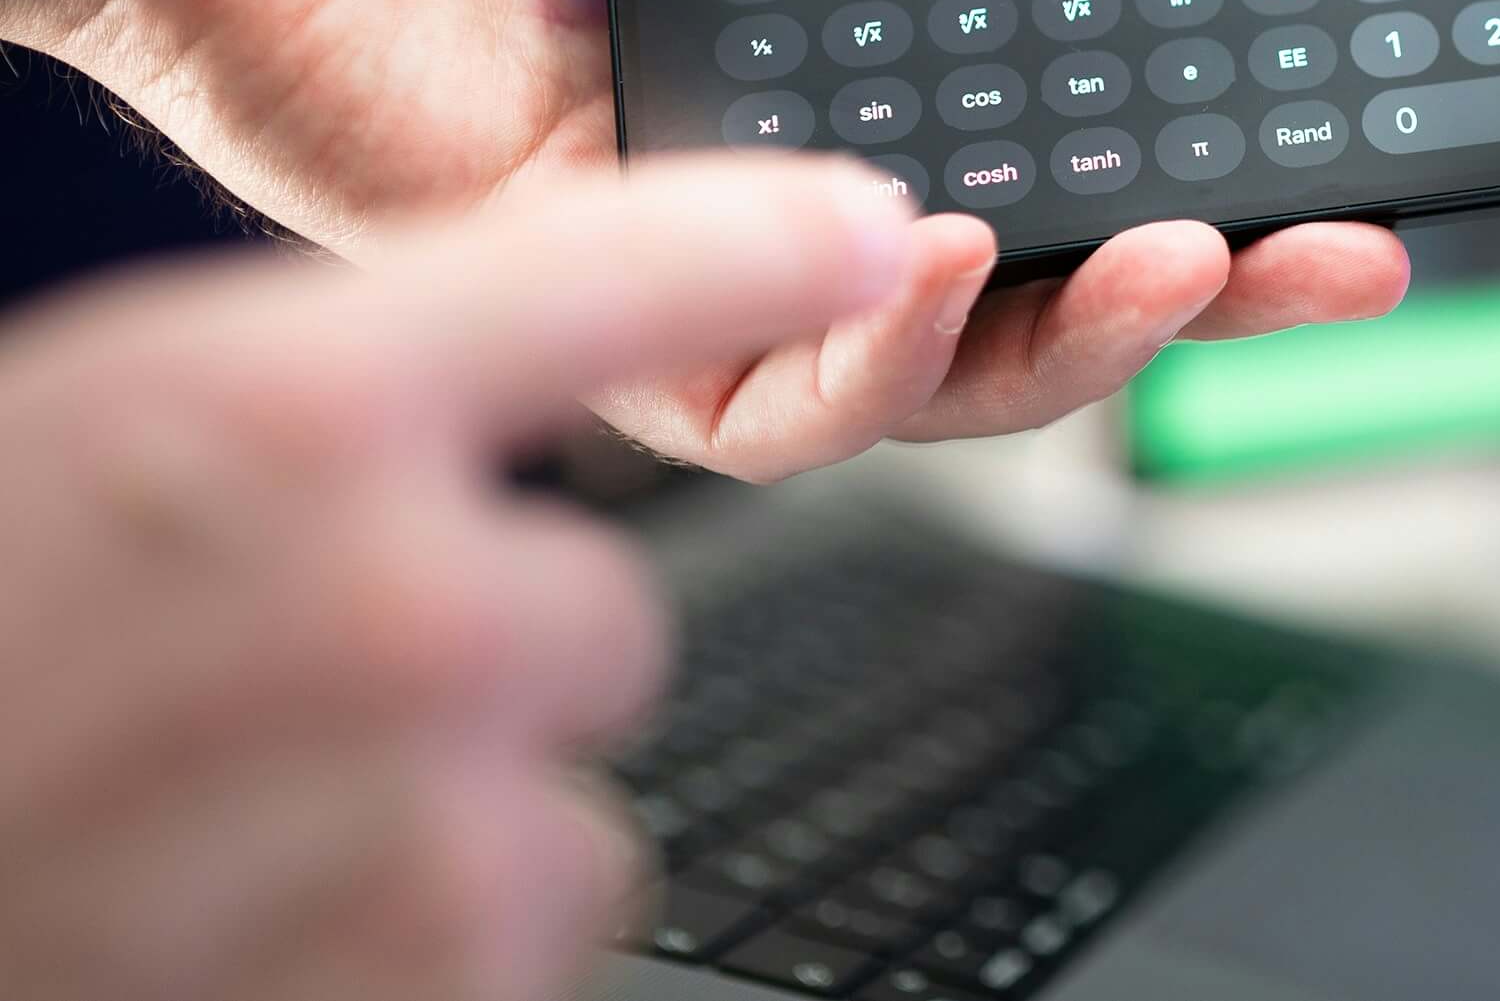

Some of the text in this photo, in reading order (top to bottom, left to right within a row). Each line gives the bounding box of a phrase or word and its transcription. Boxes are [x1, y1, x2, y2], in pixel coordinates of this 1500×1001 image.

[757, 114, 780, 135] x!
[859, 101, 893, 122] sin
[961, 89, 1002, 109] cos
[1068, 75, 1105, 96] tan
[1182, 64, 1199, 81] e
[1277, 47, 1308, 70] EE
[1384, 30, 1403, 58] 1
[963, 163, 1019, 188] cosh
[1070, 149, 1121, 173] tanh
[1275, 121, 1333, 147] Rand
[1395, 106, 1418, 135] 0
